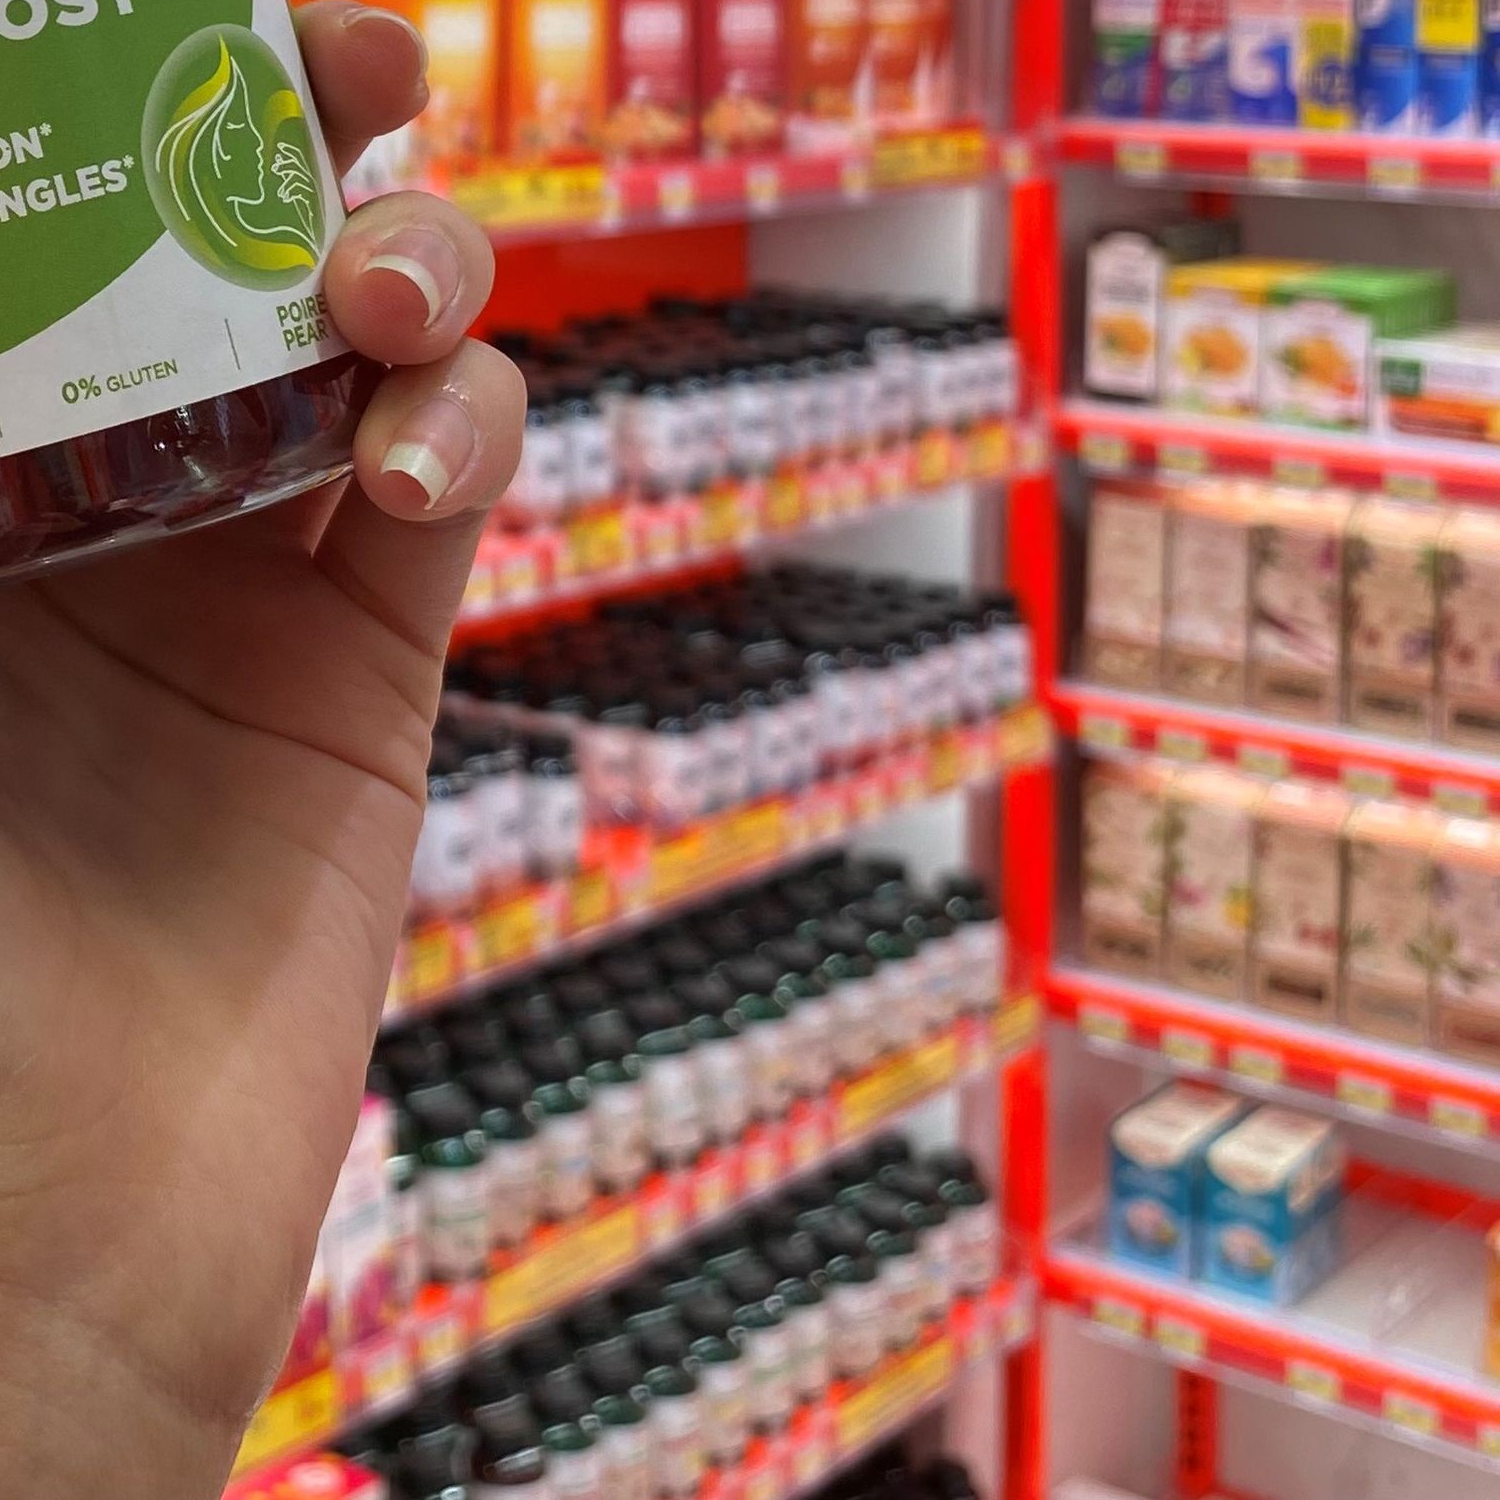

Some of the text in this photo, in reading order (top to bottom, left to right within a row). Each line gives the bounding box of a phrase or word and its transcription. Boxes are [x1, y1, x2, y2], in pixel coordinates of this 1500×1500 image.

[276, 293, 327, 327] POIRE
[282, 318, 330, 351] PEAR
[60, 358, 179, 405] 0% GLUTEN
